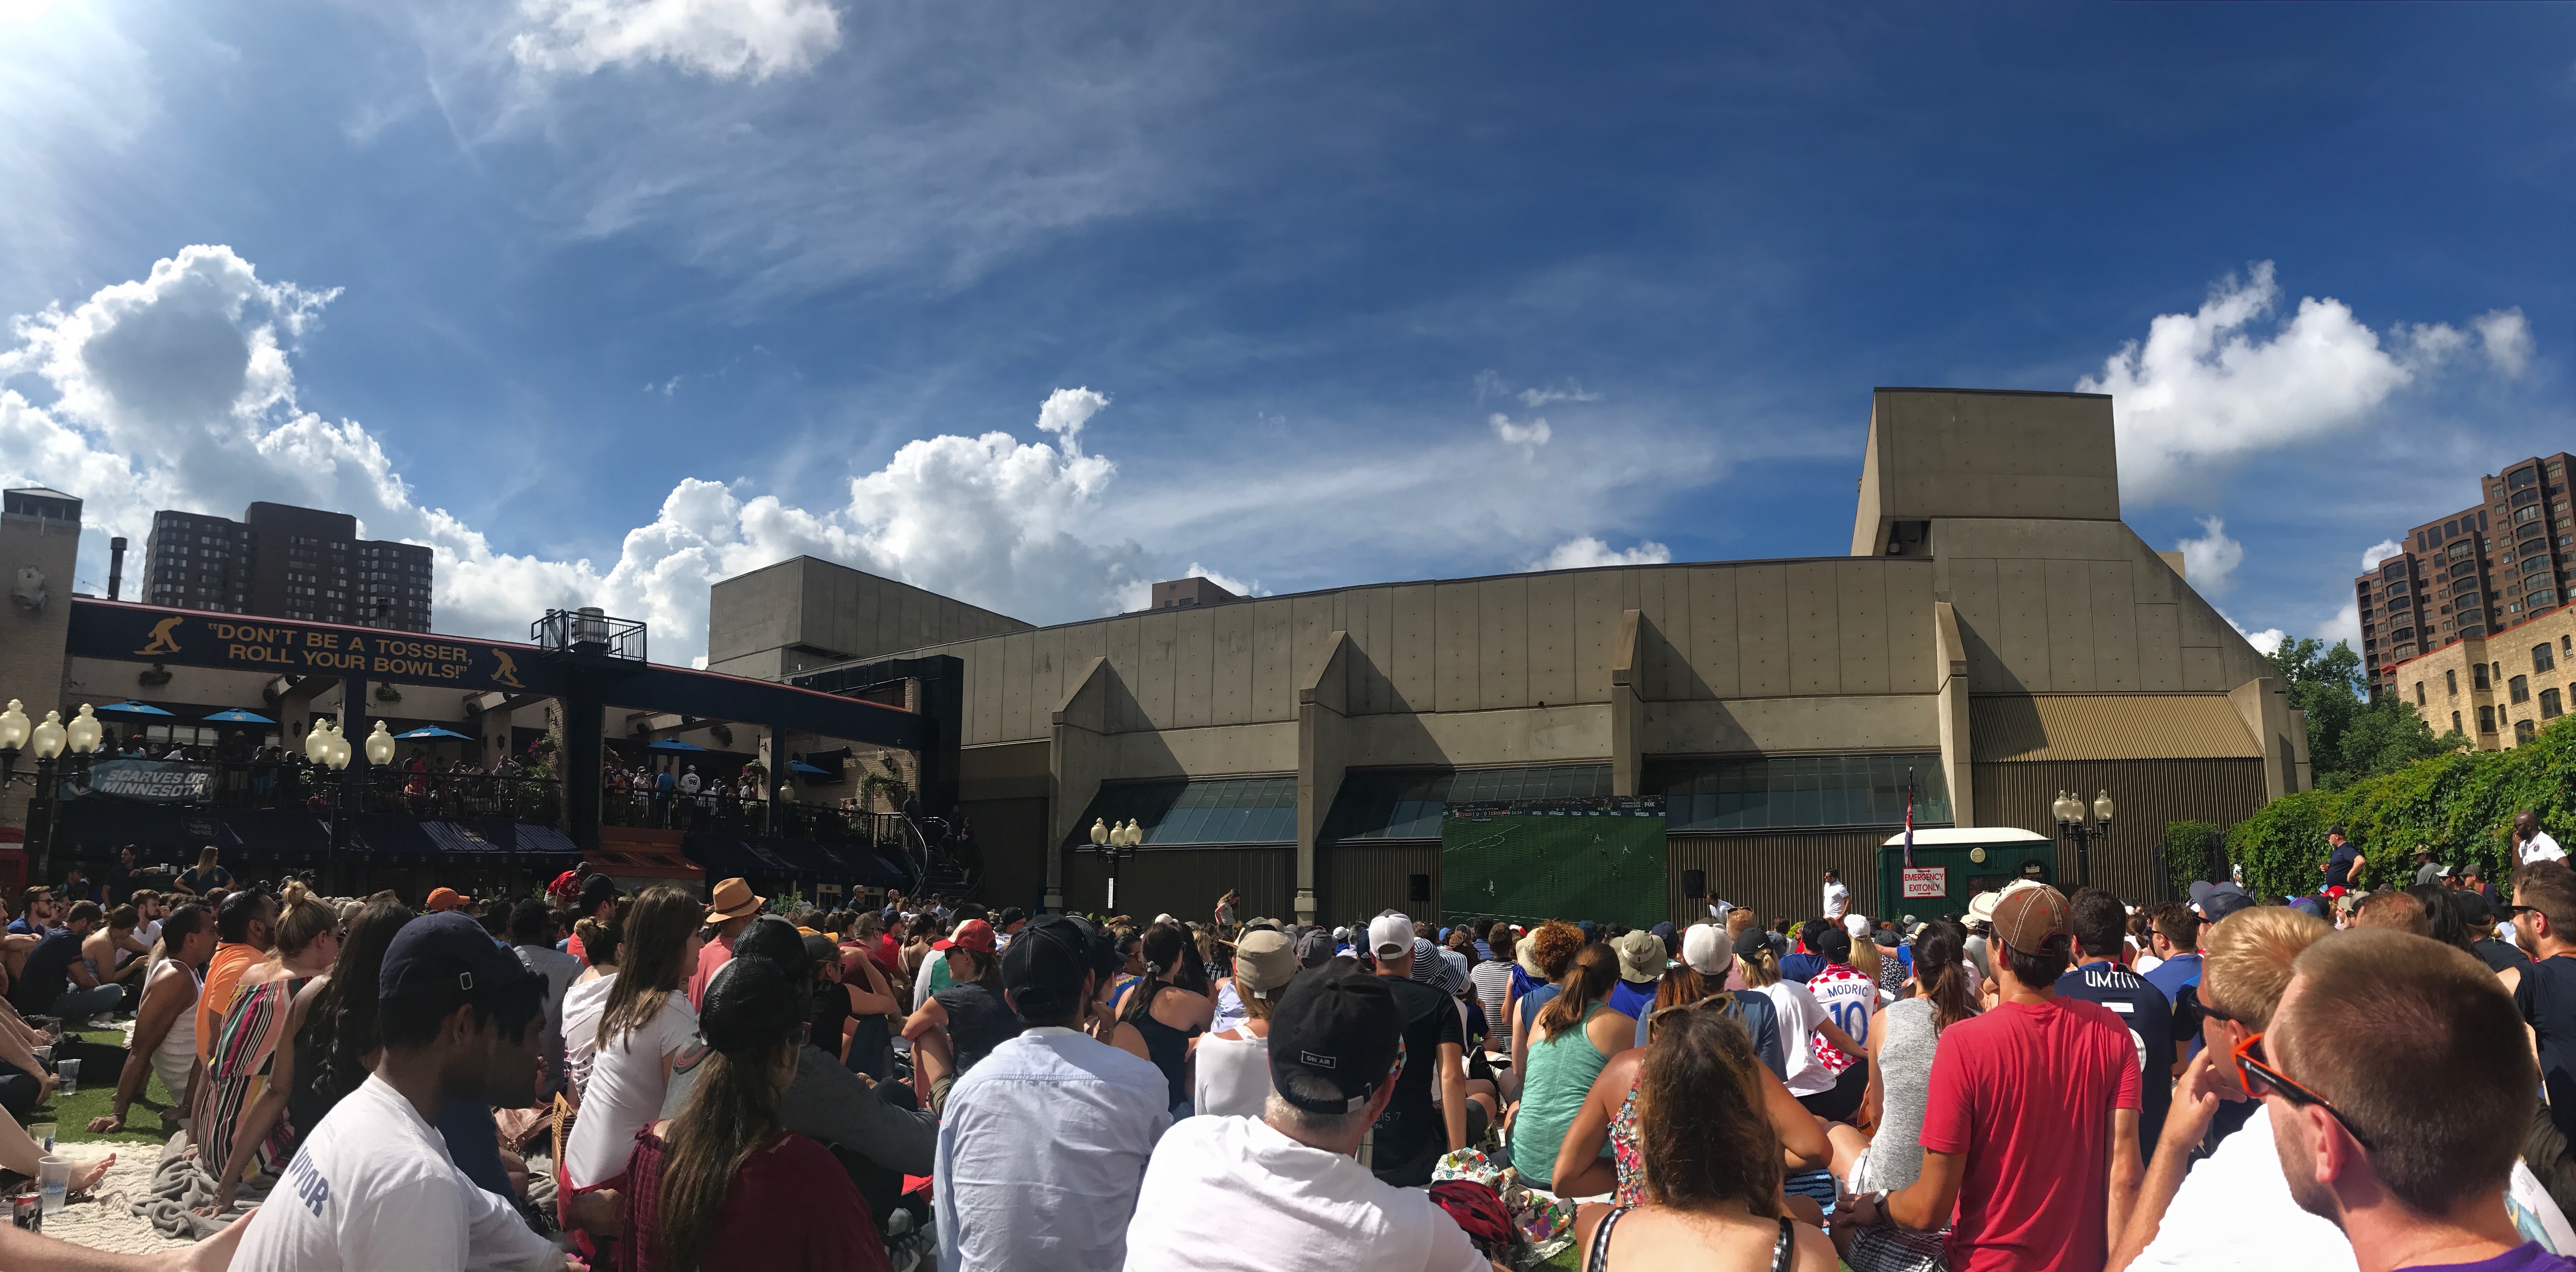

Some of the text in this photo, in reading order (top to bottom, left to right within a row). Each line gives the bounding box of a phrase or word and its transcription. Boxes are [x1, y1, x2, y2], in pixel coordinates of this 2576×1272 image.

[229, 644, 295, 664] ROLL
[302, 650, 366, 670] YOUR
[307, 632, 339, 649] BE
[348, 637, 365, 651] A
[375, 639, 473, 666] TOSSER,
[107, 770, 184, 784] SCARVES
[100, 781, 204, 797] MINNESOTA
[2085, 971, 2140, 989] UMTITI
[1827, 984, 1868, 998] MODRIĆ
[1829, 1001, 1868, 1047] 10
[1396, 1112, 1401, 1120] 7
[289, 1140, 329, 1218] VIVOR
